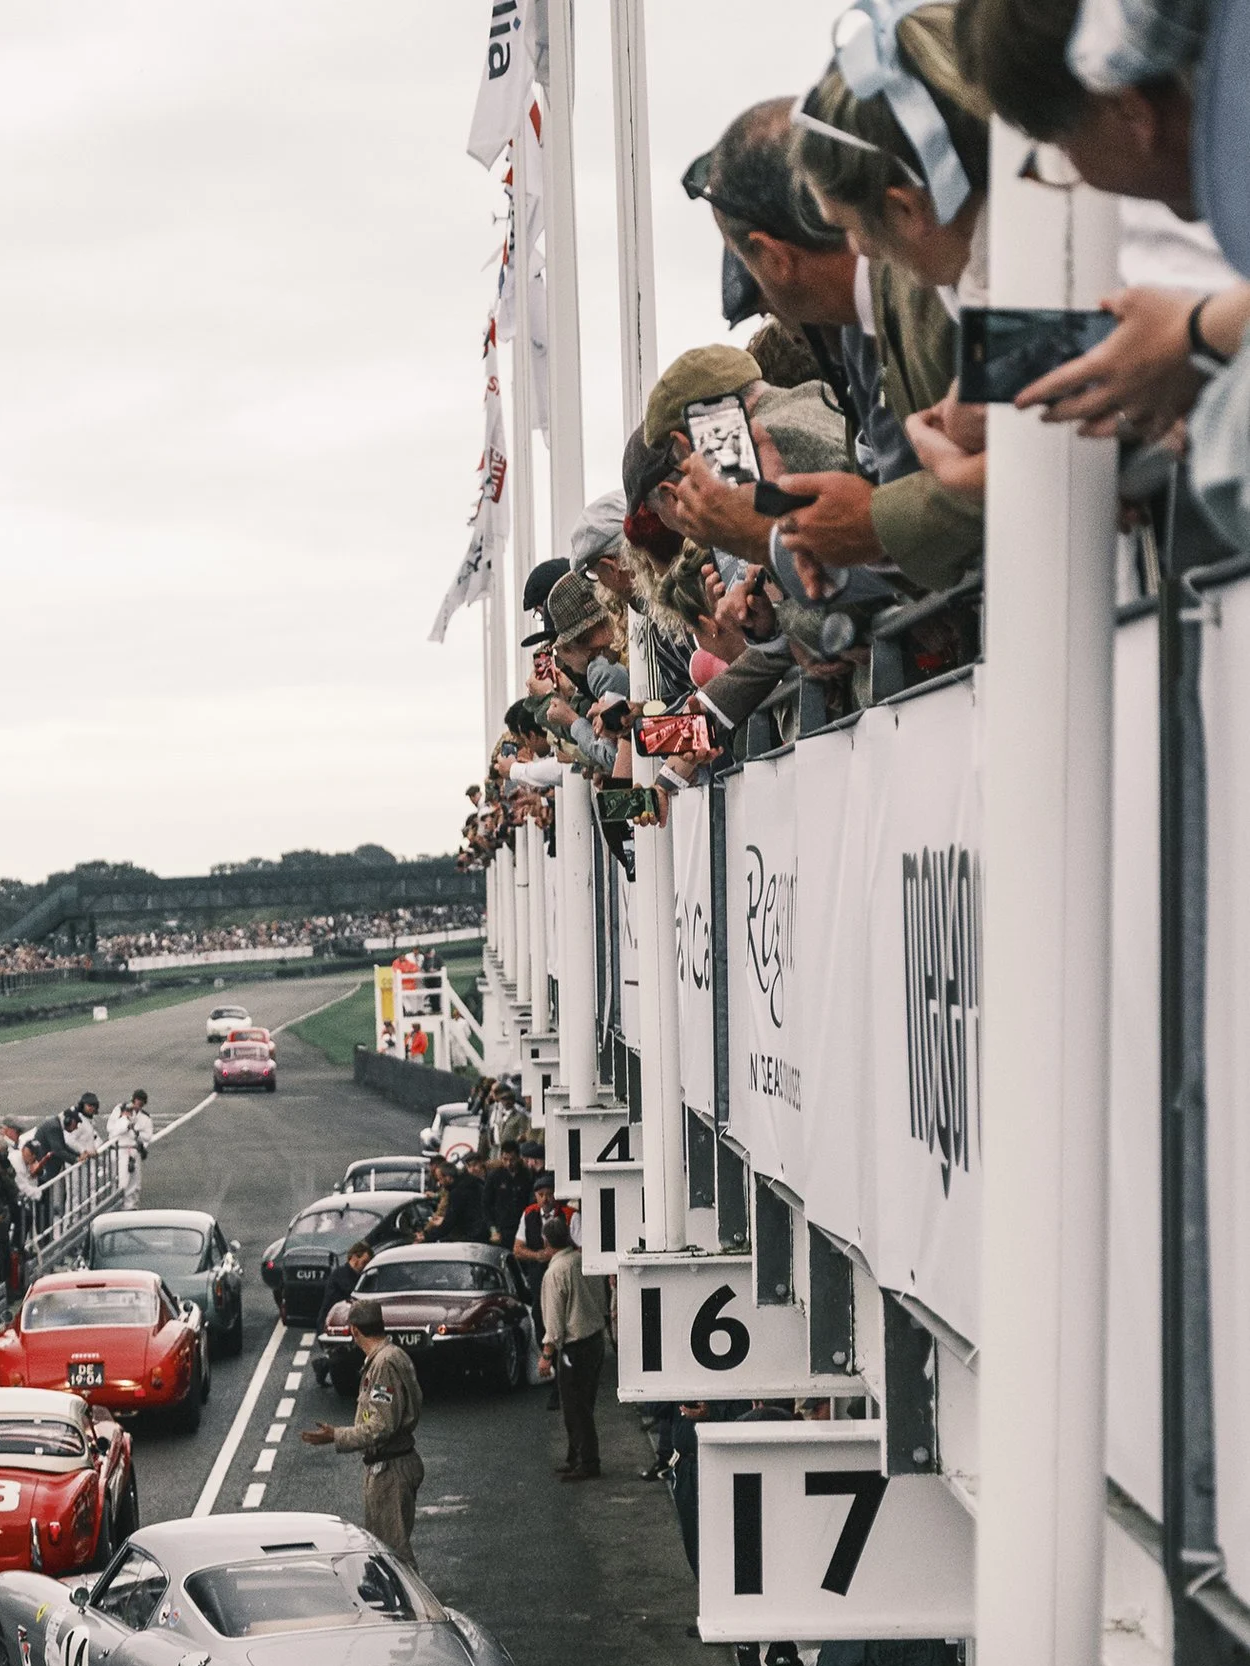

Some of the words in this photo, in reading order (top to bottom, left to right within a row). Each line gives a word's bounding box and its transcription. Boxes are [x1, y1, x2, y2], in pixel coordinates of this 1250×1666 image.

[78, 1364, 95, 1375] DE
[641, 1284, 750, 1372] 16
[733, 1470, 888, 1597] 17
